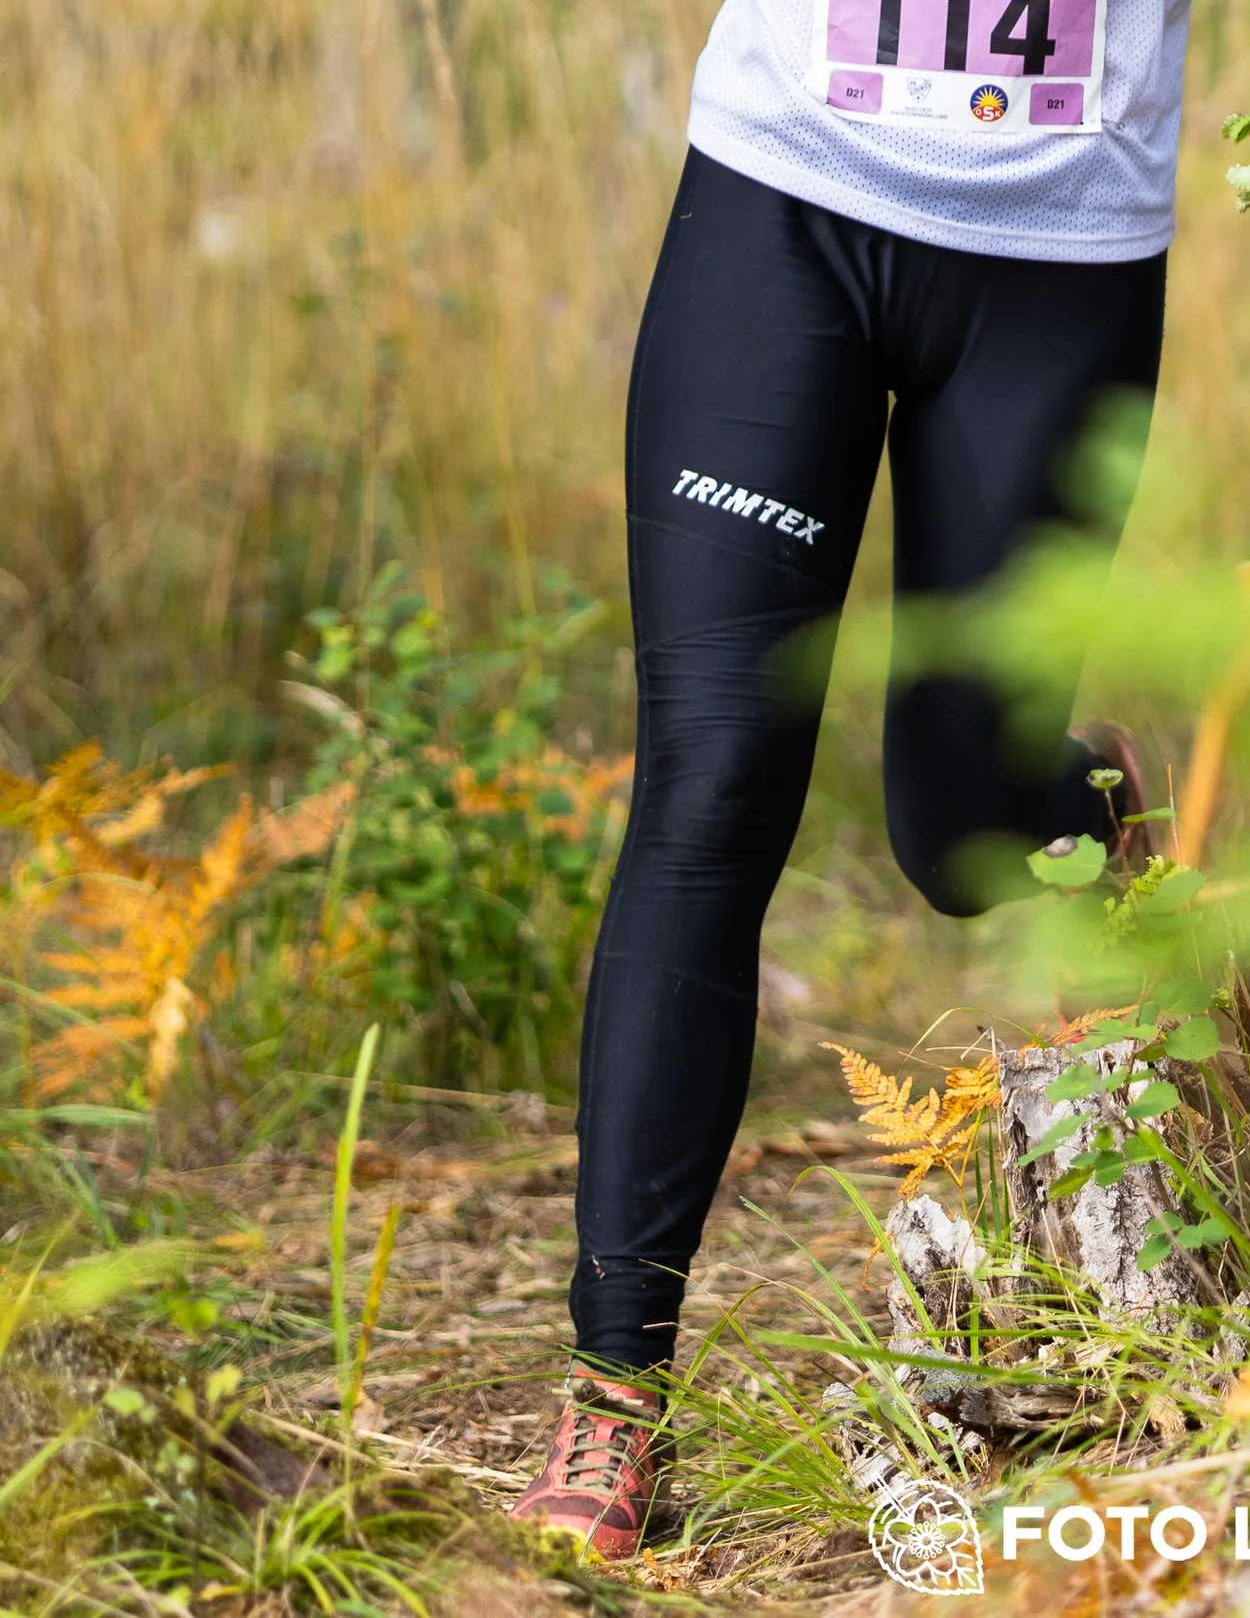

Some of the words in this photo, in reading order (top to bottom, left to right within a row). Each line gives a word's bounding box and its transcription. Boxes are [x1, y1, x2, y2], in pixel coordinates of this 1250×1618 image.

[845, 86, 865, 100] D21
[1046, 97, 1065, 110] D21
[975, 105, 1002, 121] OSK
[672, 469, 825, 545] TRIMTEX
